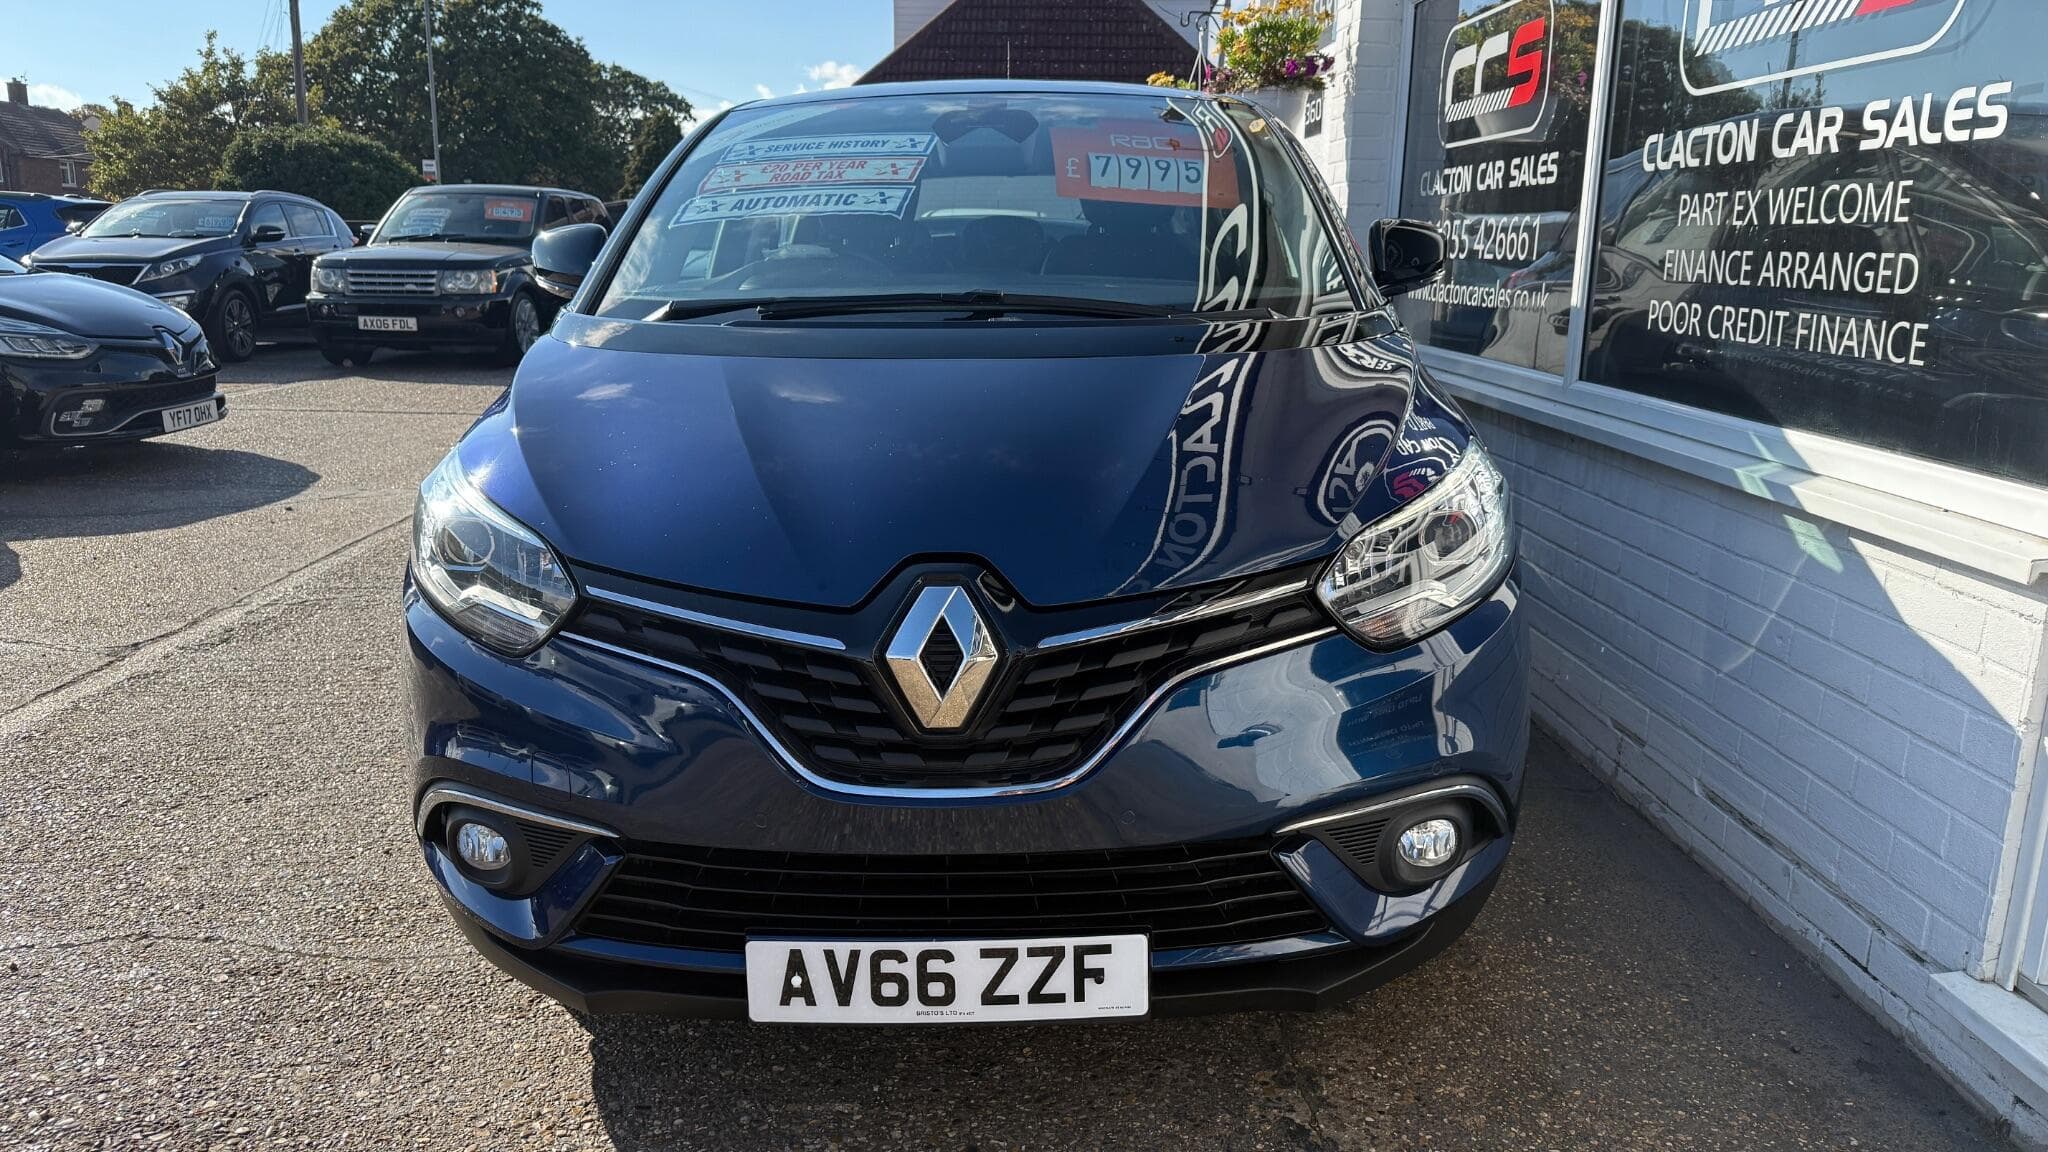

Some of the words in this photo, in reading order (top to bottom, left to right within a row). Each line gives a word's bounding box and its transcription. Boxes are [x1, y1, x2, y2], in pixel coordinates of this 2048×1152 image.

[1642, 118, 1759, 172] CLACTON
[1771, 106, 1844, 158] CAR
[1859, 80, 2012, 151] SALES
[763, 141, 824, 153] SERVICE
[828, 139, 890, 149] HISTORY
[760, 164, 788, 174] £20
[792, 161, 823, 172] PER
[827, 160, 868, 170] YEAR
[769, 171, 814, 182] ROAD
[816, 169, 846, 180] TAX
[1094, 155, 1200, 184] 7995
[1420, 164, 1473, 197] CLACTON
[1476, 160, 1505, 191] CAR
[1509, 151, 1560, 188] SALES
[728, 193, 859, 212] AUTOMATIC
[1677, 190, 1729, 227] PART
[1732, 190, 1759, 226] EX
[1768, 179, 1914, 226] WELCOME
[1473, 214, 1541, 261] 426661
[1663, 249, 1753, 285] FINANCE
[1757, 251, 1919, 295] ARRANGED
[363, 318, 390, 329] AX06
[391, 319, 413, 329] FDL
[1647, 299, 1702, 336] POOR
[1707, 304, 1789, 347] CREDIT
[1795, 311, 1929, 367] FINANCE
[169, 408, 192, 428] YF17
[194, 404, 213, 422] OHX
[779, 948, 956, 1007] AV66
[979, 943, 1112, 1005] ZZF
